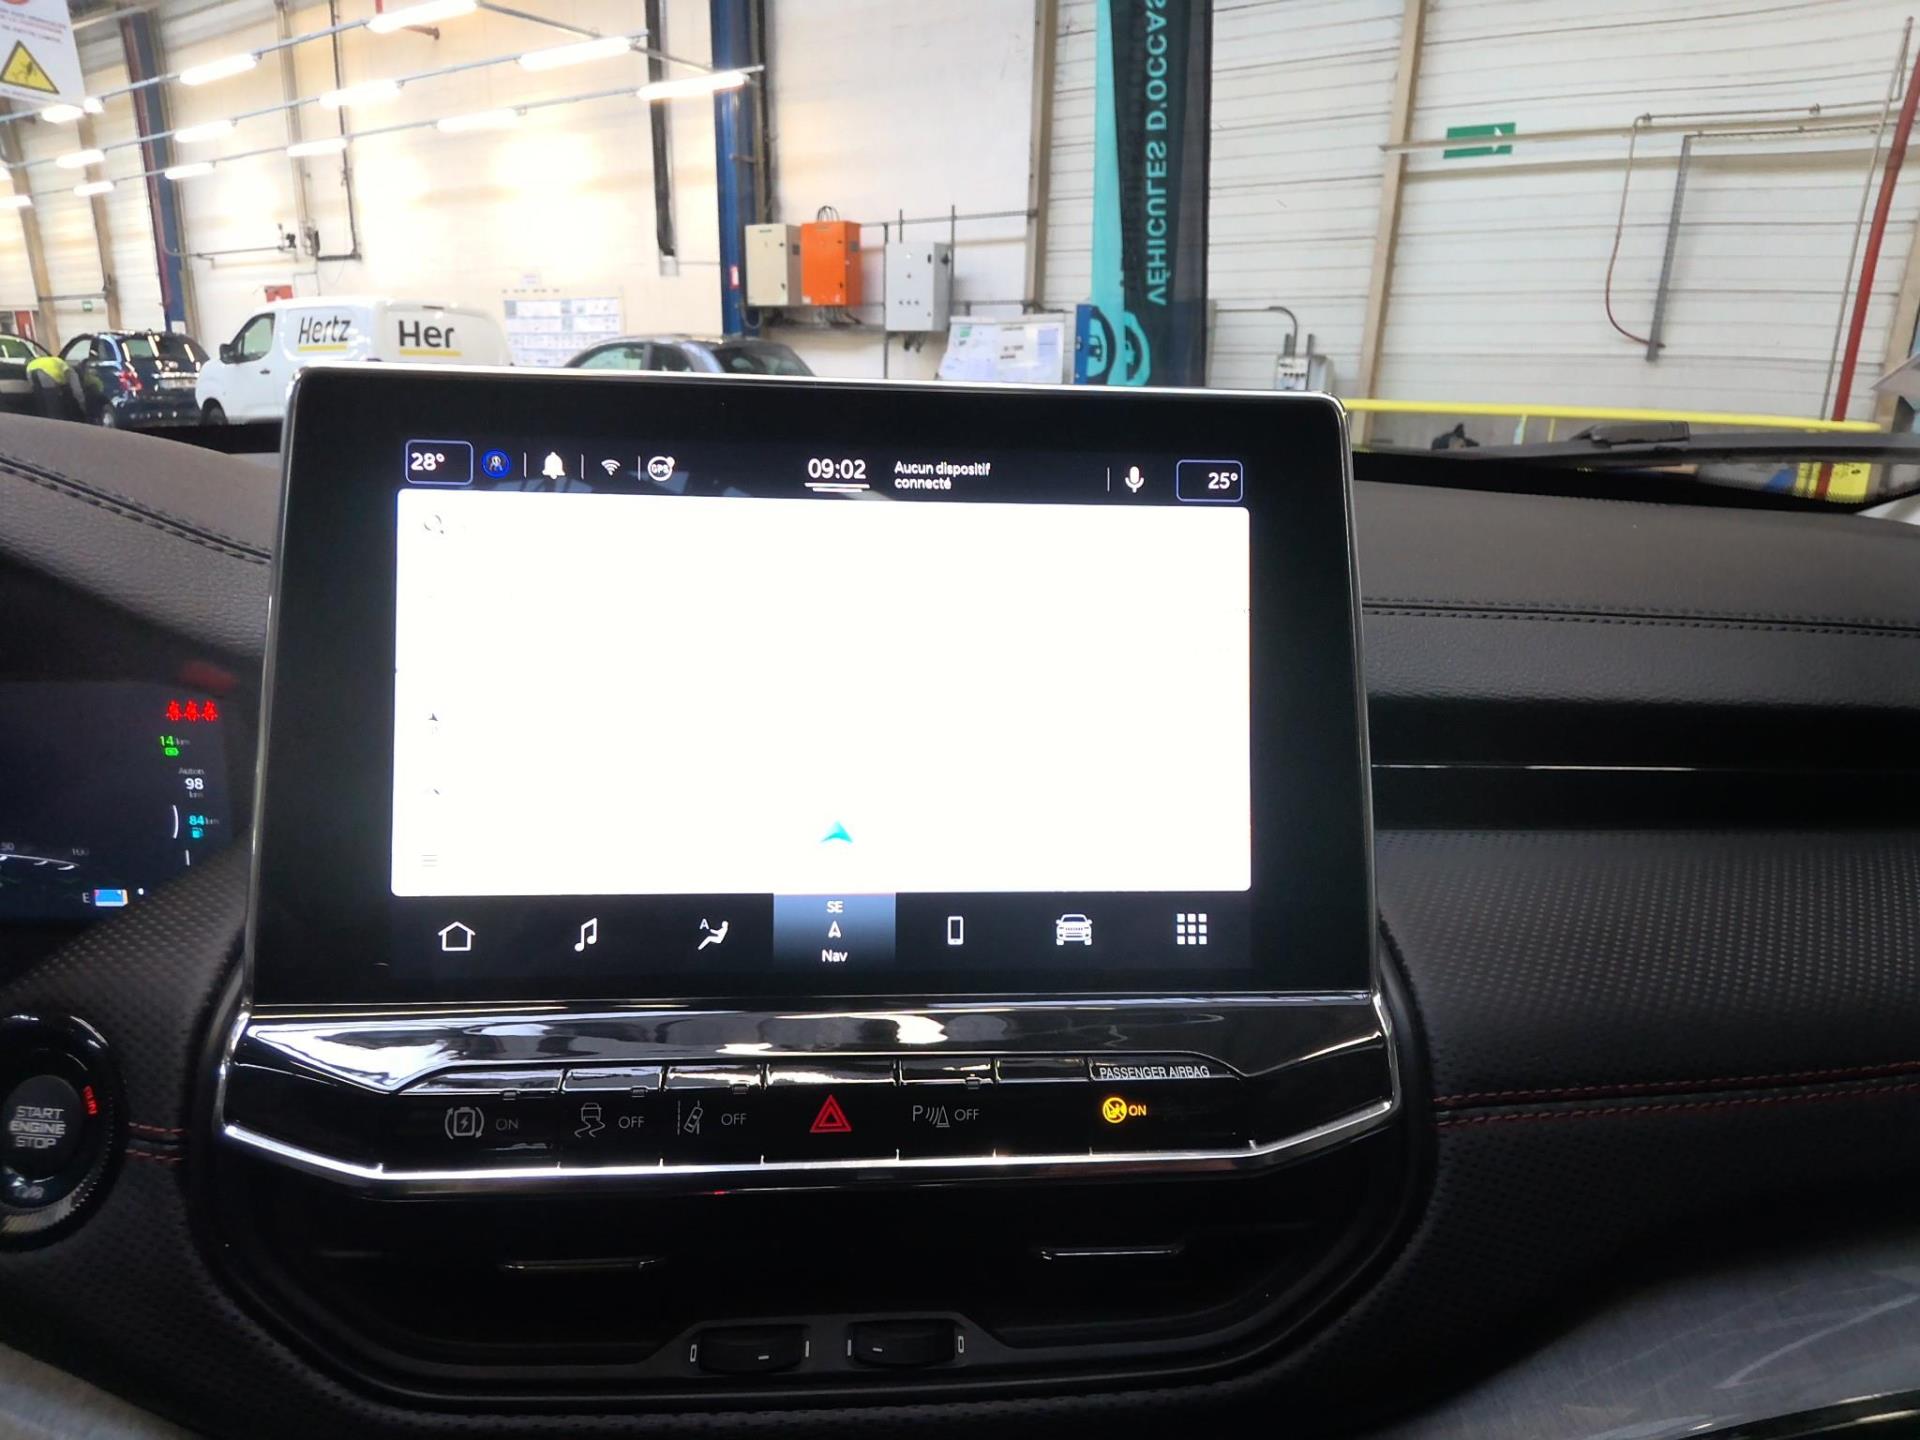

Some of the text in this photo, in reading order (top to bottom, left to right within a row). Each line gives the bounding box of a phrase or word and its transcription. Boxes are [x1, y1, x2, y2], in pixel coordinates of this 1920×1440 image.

[299, 314, 352, 344] Hertz
[410, 452, 445, 471] 28°
[807, 458, 867, 479] 09:02
[894, 461, 991, 477] Aucun dispositif
[894, 476, 952, 490] connecté
[1208, 472, 1238, 489] 25°
[160, 735, 174, 746] 14
[185, 777, 205, 790] 98
[188, 815, 205, 826] 84
[826, 900, 844, 913] SE
[821, 949, 848, 962] Nav
[1099, 1065, 1211, 1080] PASSENGER AIRBAG
[15, 1105, 65, 1120] START
[954, 1108, 980, 1121] OFF
[1128, 1104, 1147, 1117] ON
[495, 1118, 519, 1130] ON
[618, 1116, 645, 1129] OFF
[721, 1113, 748, 1126] OFF
[9, 1121, 67, 1135] ENGINE
[15, 1136, 57, 1149] STOP
